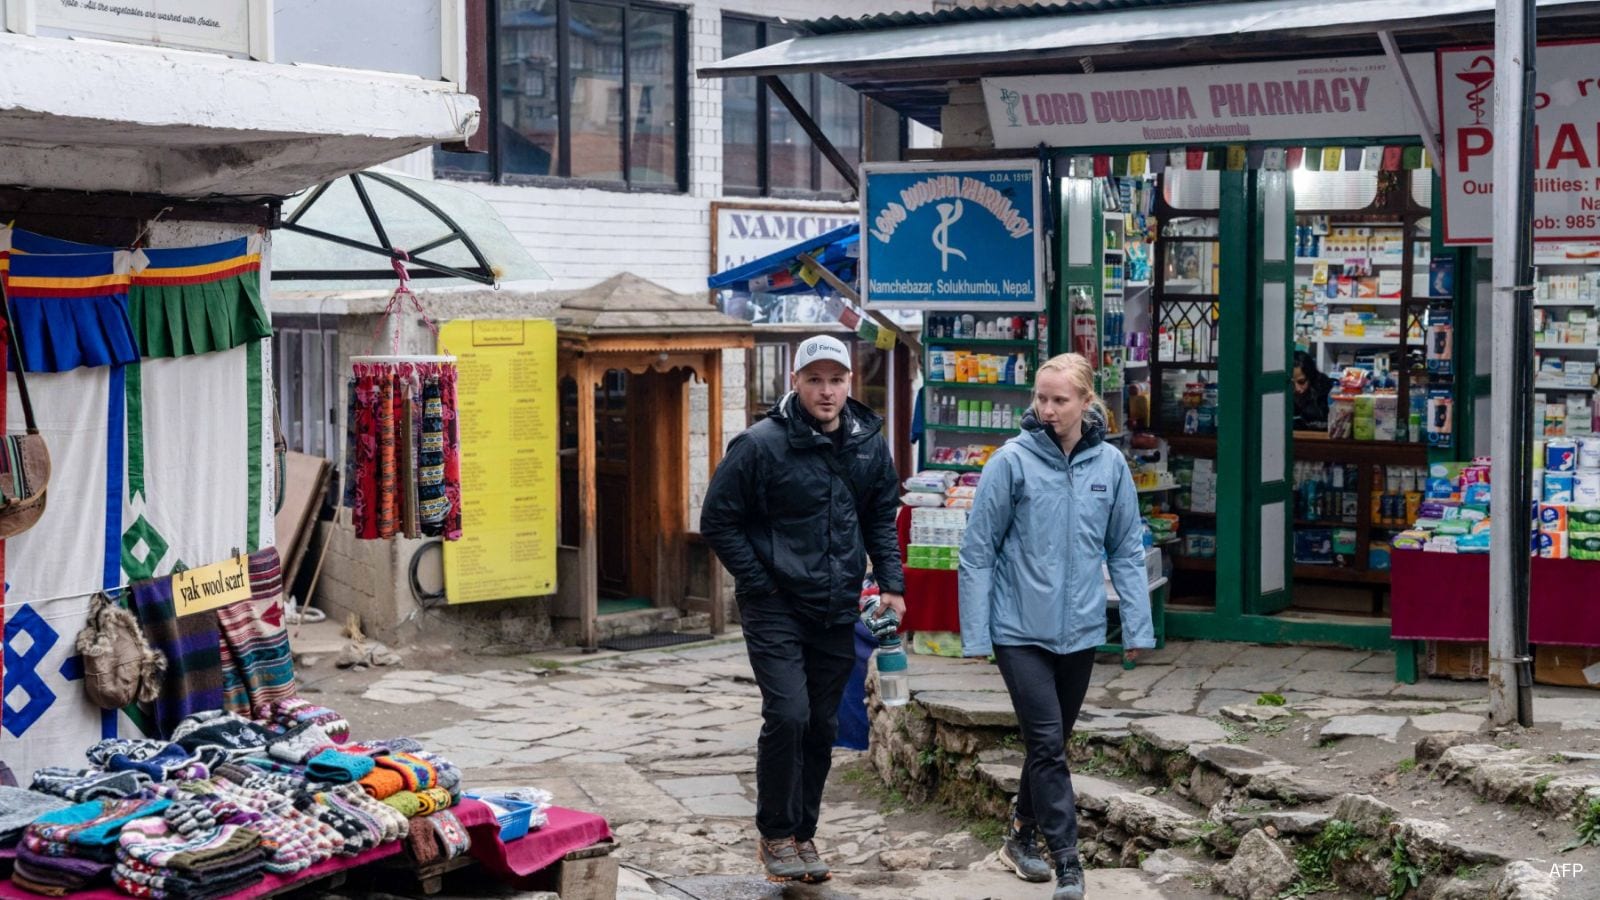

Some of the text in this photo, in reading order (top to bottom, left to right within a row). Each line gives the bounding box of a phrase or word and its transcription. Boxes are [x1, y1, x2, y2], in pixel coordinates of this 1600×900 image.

[84, 0, 97, 10] All
[98, 4, 108, 12] the
[110, 6, 144, 16] vegetables
[158, 12, 181, 22] washed
[182, 15, 196, 25] with
[1022, 76, 1370, 126] LORD BUDDHA PHARMACY
[1142, 123, 1251, 140] Namche, Solukhumbu
[1457, 122, 1600, 173] PA
[990, 173, 1033, 182] D.D.A. 15197
[869, 175, 1033, 244] LORD BUDDHA PHARMACY
[729, 213, 857, 240] NAMCH
[1534, 216, 1560, 230] ob:
[869, 278, 1033, 297] Namchebazar, Solukhumbu, Nepal.
[180, 564, 245, 607] yak wool scarf
